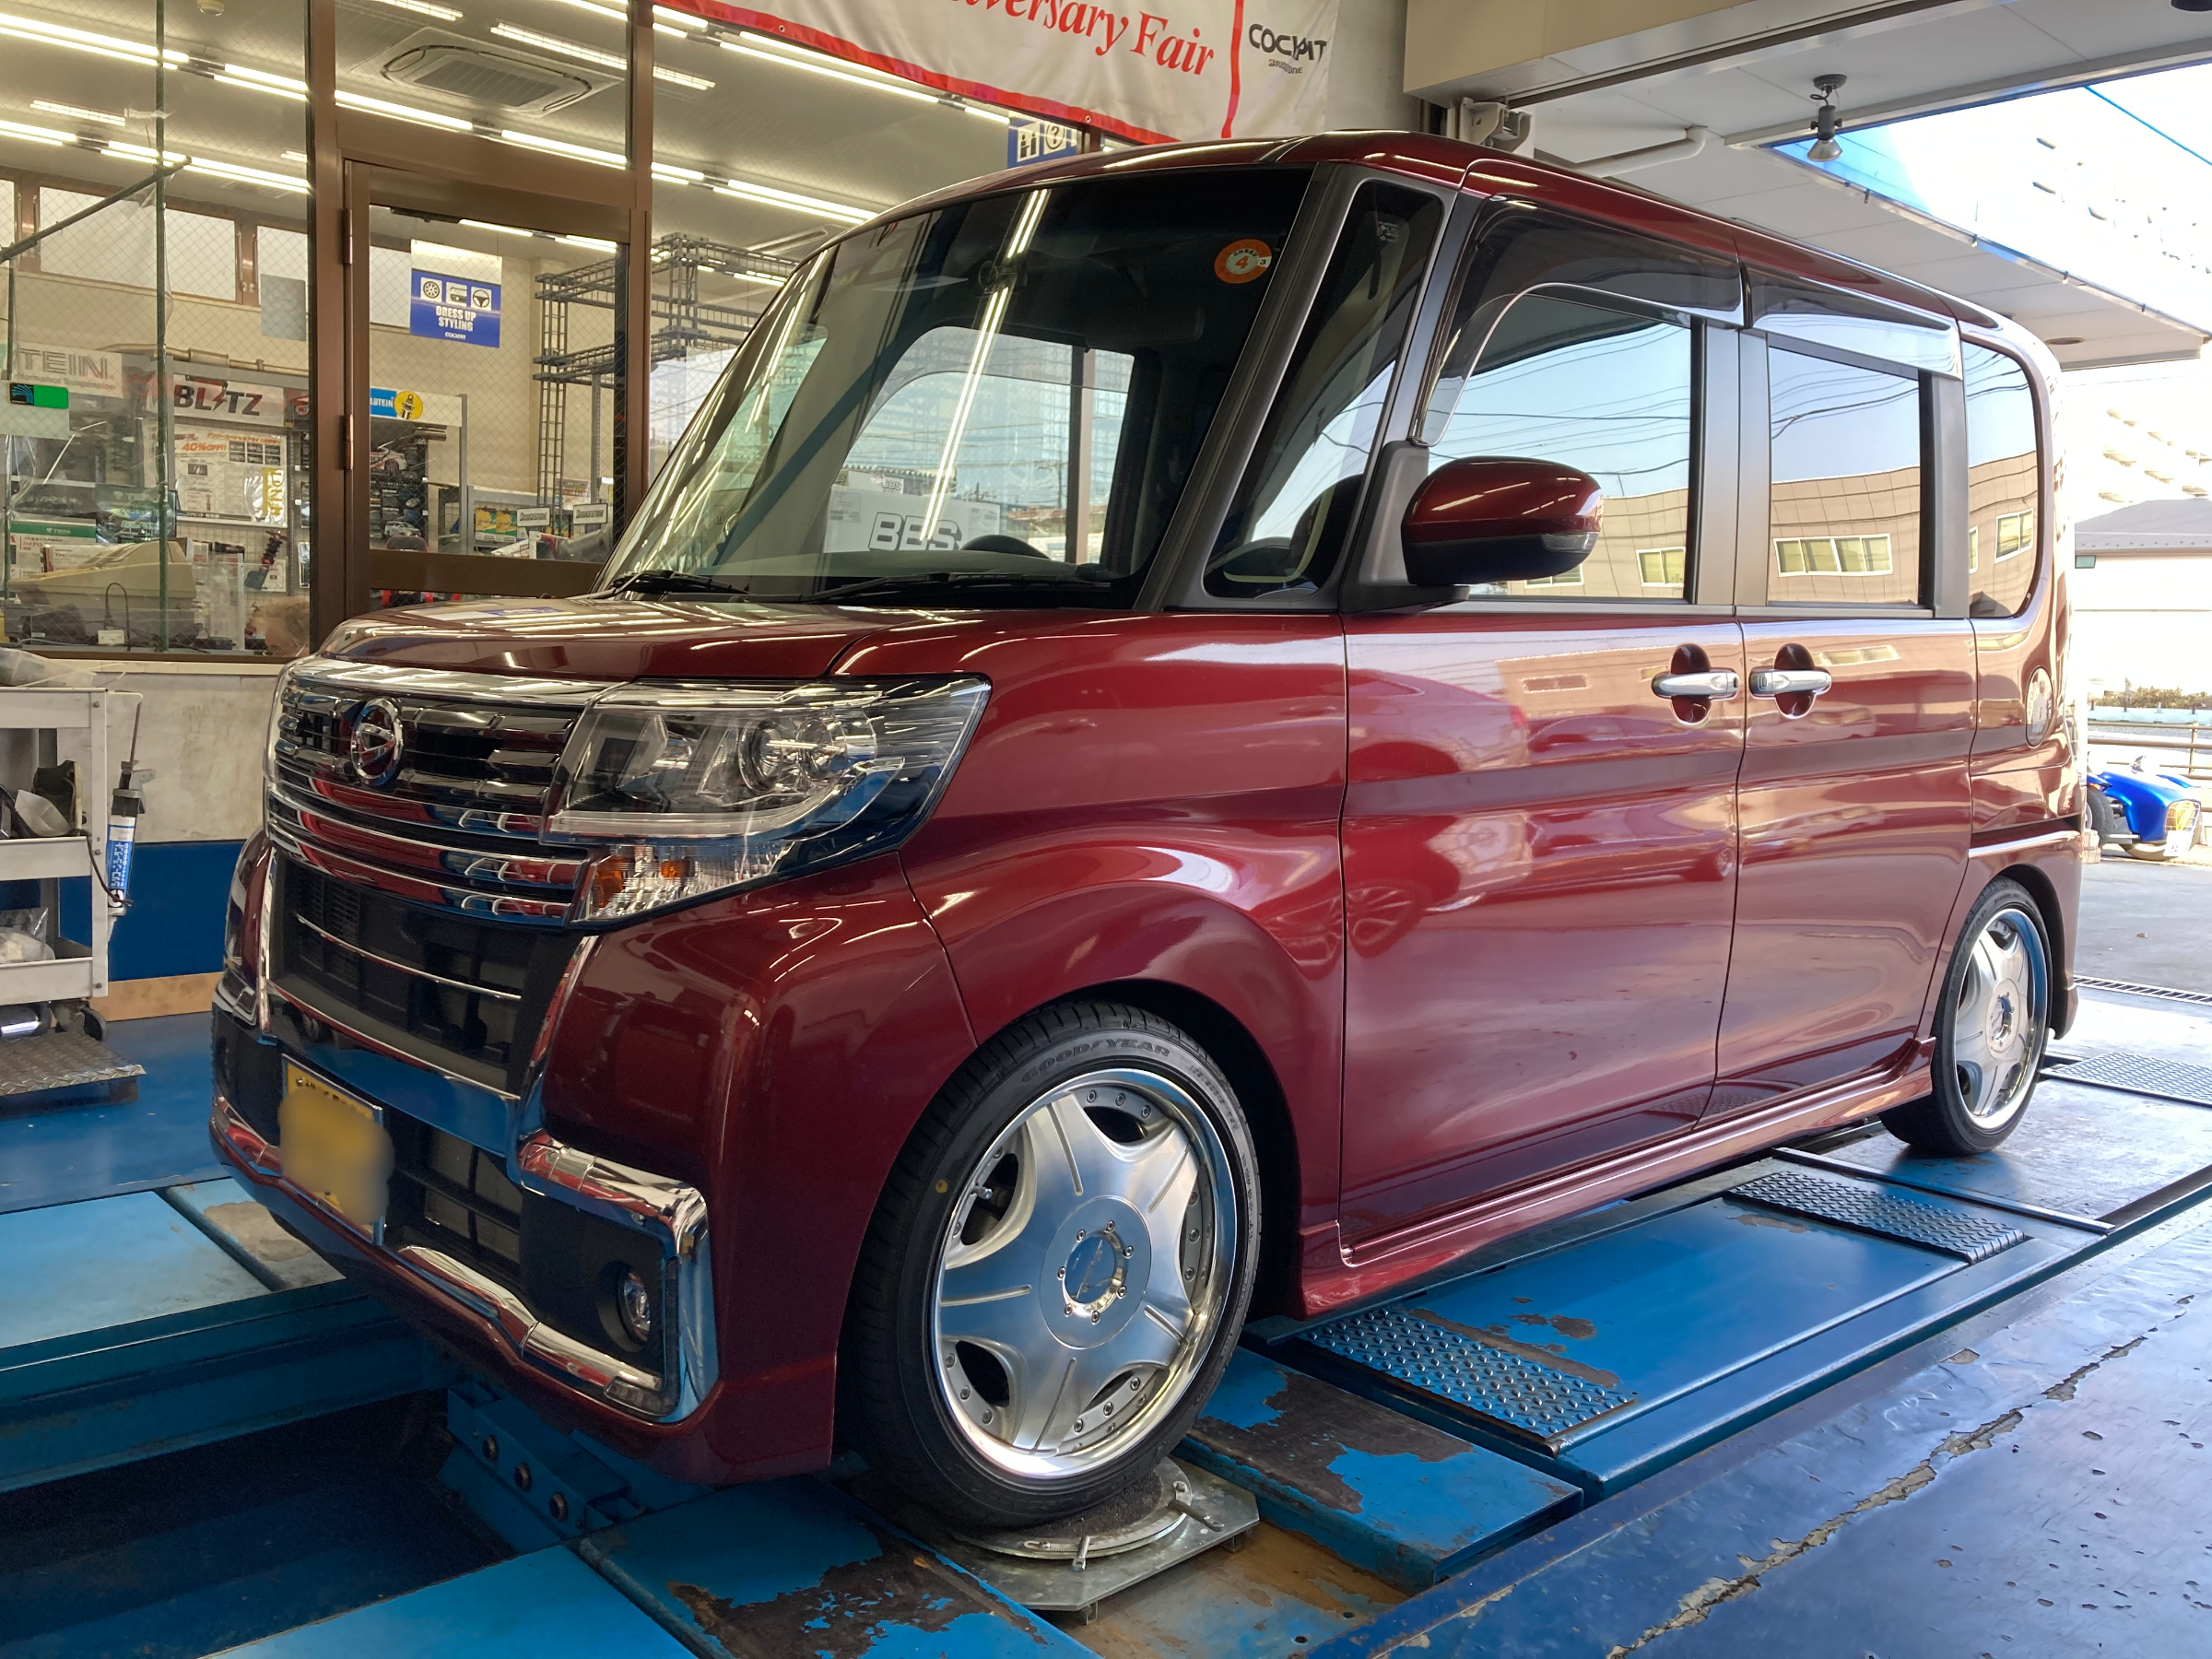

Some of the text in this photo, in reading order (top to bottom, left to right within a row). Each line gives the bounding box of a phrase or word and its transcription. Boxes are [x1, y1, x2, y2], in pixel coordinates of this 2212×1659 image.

[1130, 11, 1214, 75] Fair
[1235, 255, 1249, 268] 4
[436, 305, 477, 322] DRESS UP
[438, 316, 474, 332] STYLING
[18, 347, 108, 379] TEIN
[173, 383, 264, 417] BLITZ
[882, 479, 901, 490] BBS
[868, 512, 962, 551] BBS
[1022, 1038, 1171, 1083] GOODYEAR
